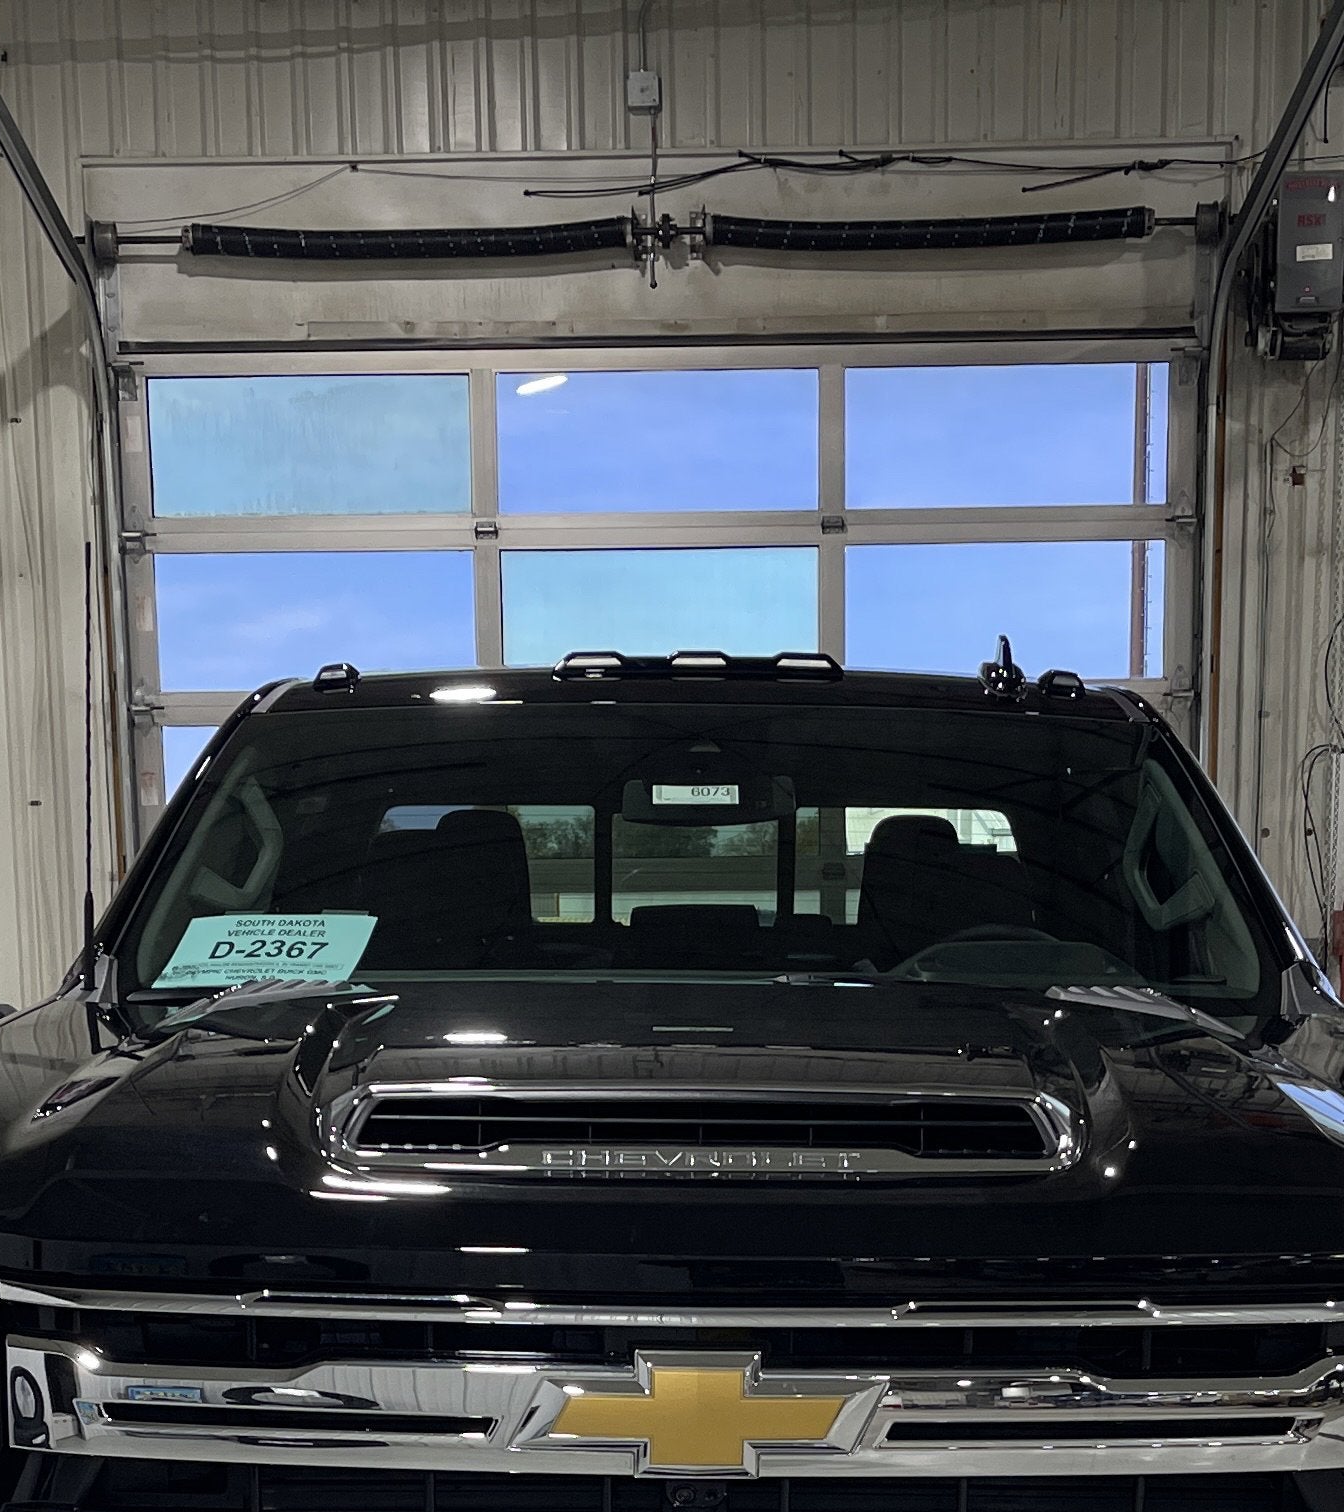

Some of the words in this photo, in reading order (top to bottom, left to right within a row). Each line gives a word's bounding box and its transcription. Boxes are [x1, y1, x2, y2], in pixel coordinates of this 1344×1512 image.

[235, 919, 276, 928] SOUTH
[278, 919, 326, 928] DAKOTA
[227, 929, 276, 938] VEHICLE
[278, 929, 326, 938] DEALER
[208, 940, 329, 960] D-2367
